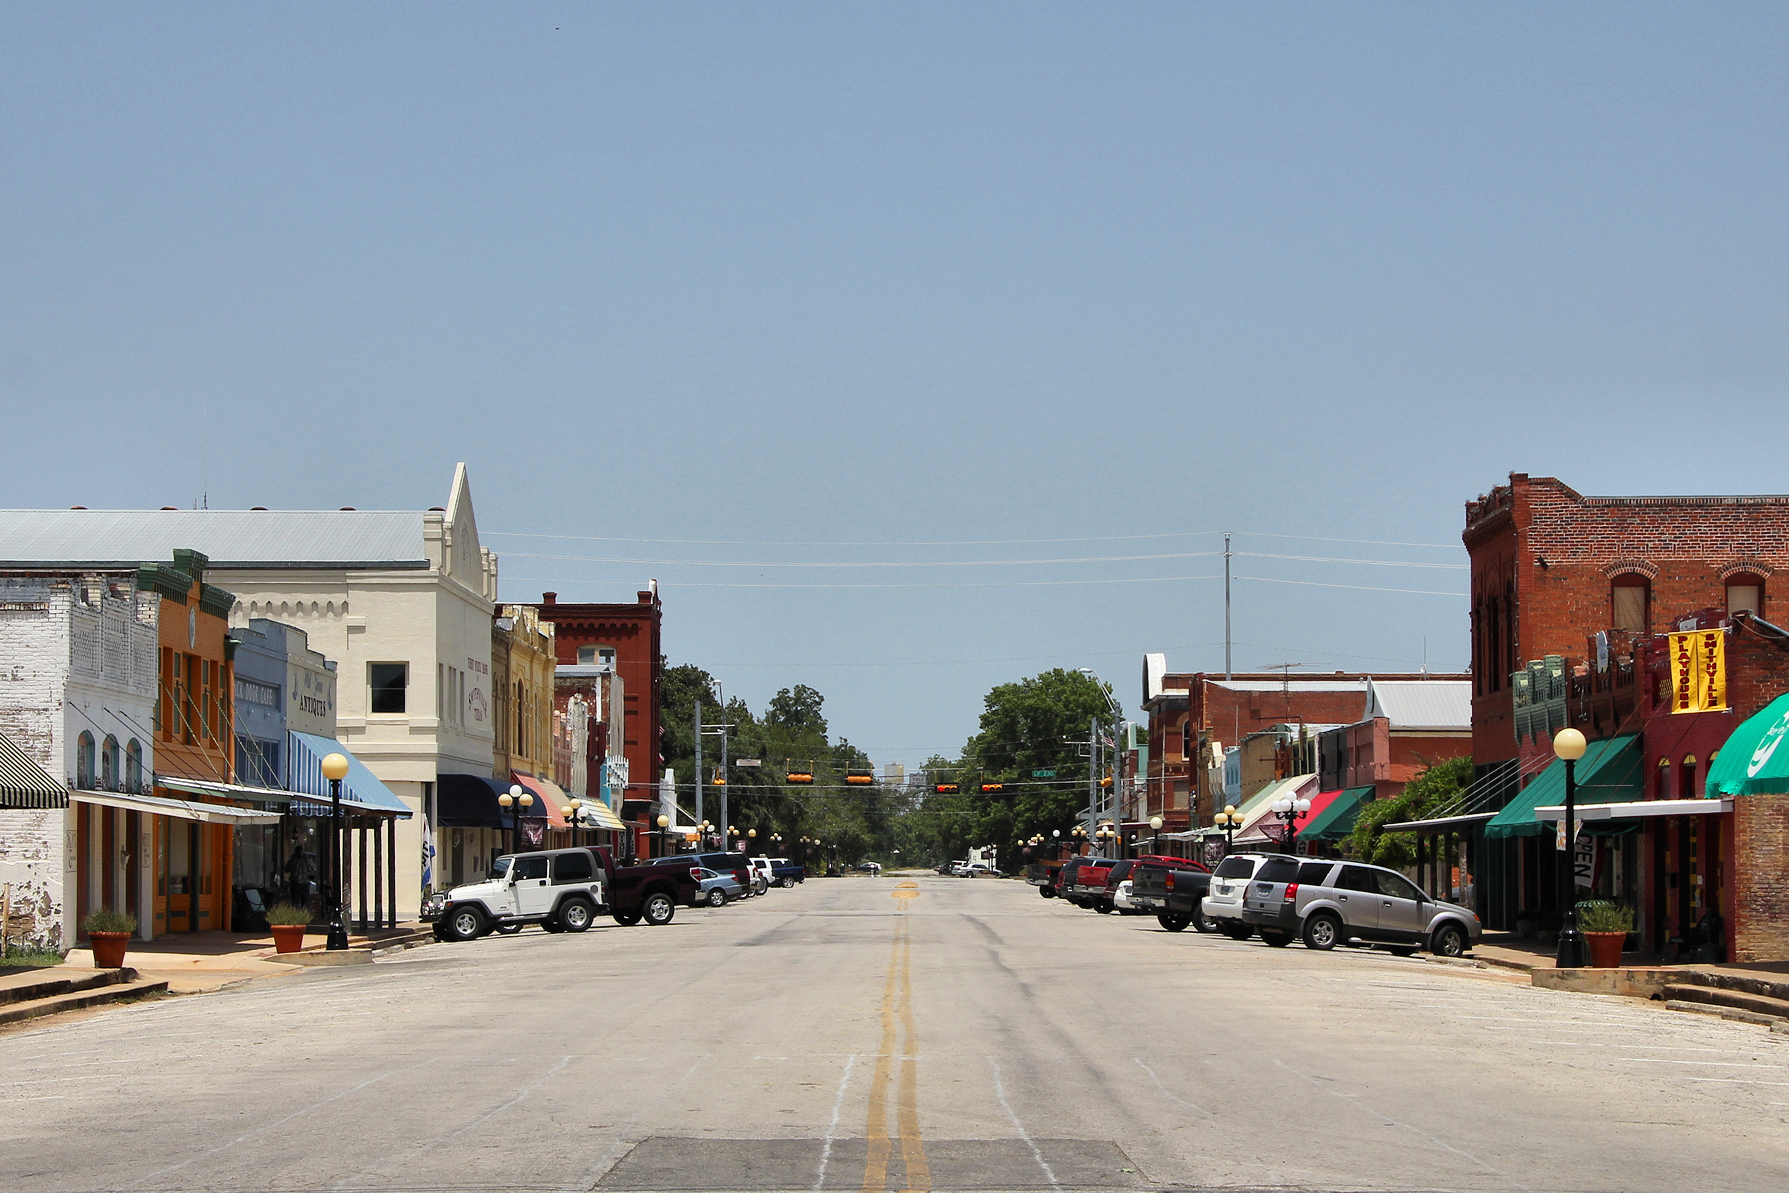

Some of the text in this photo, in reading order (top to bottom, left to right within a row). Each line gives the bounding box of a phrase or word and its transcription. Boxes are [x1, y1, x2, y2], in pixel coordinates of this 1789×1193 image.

[1678, 636, 1690, 709] PLAYHOUSE
[1705, 634, 1717, 706] SMITHVILLE
[260, 687, 273, 705] CAFE
[299, 694, 327, 717] ANTIQUES
[1575, 833, 1593, 878] OPEN
